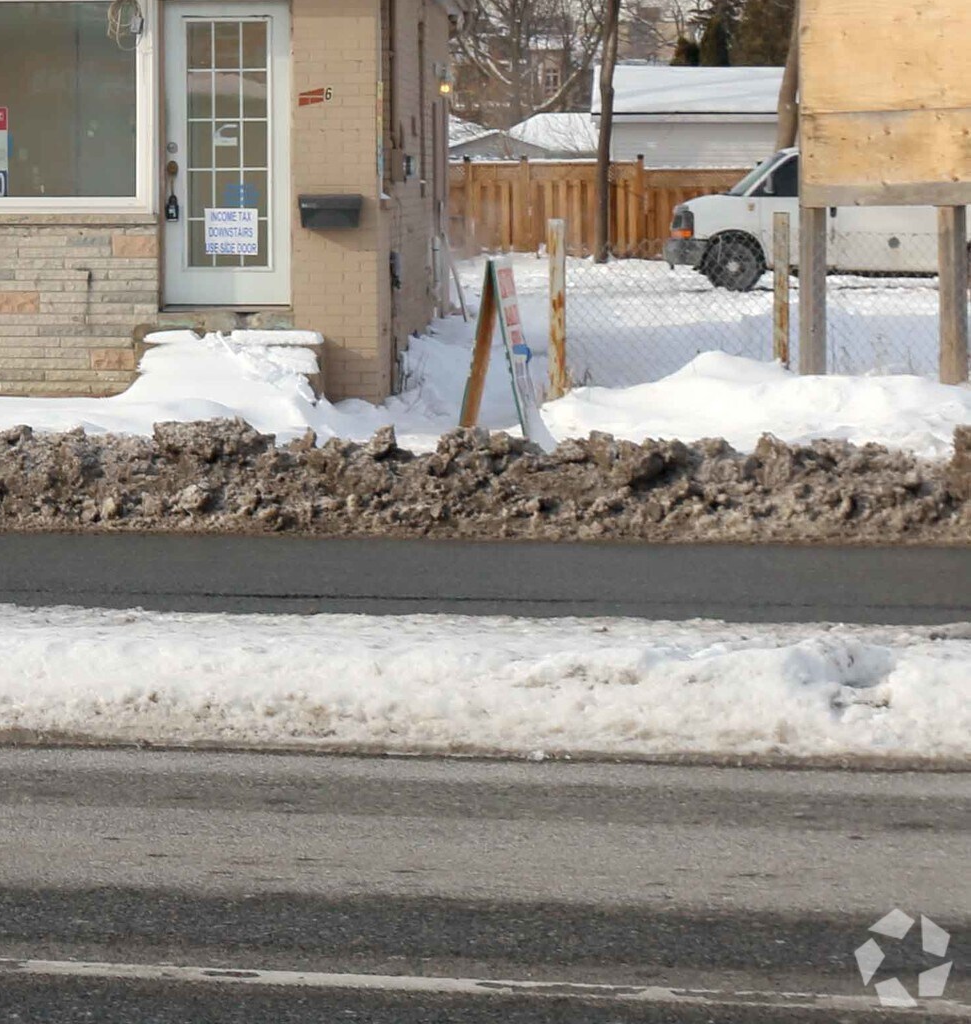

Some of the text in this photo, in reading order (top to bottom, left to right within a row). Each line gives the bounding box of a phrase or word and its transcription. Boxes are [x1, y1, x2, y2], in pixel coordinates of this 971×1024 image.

[210, 211, 252, 222] INCOME TAX
[208, 227, 254, 238] DOWNSTAIRS
[205, 242, 257, 253] USE SIDE DOOR
